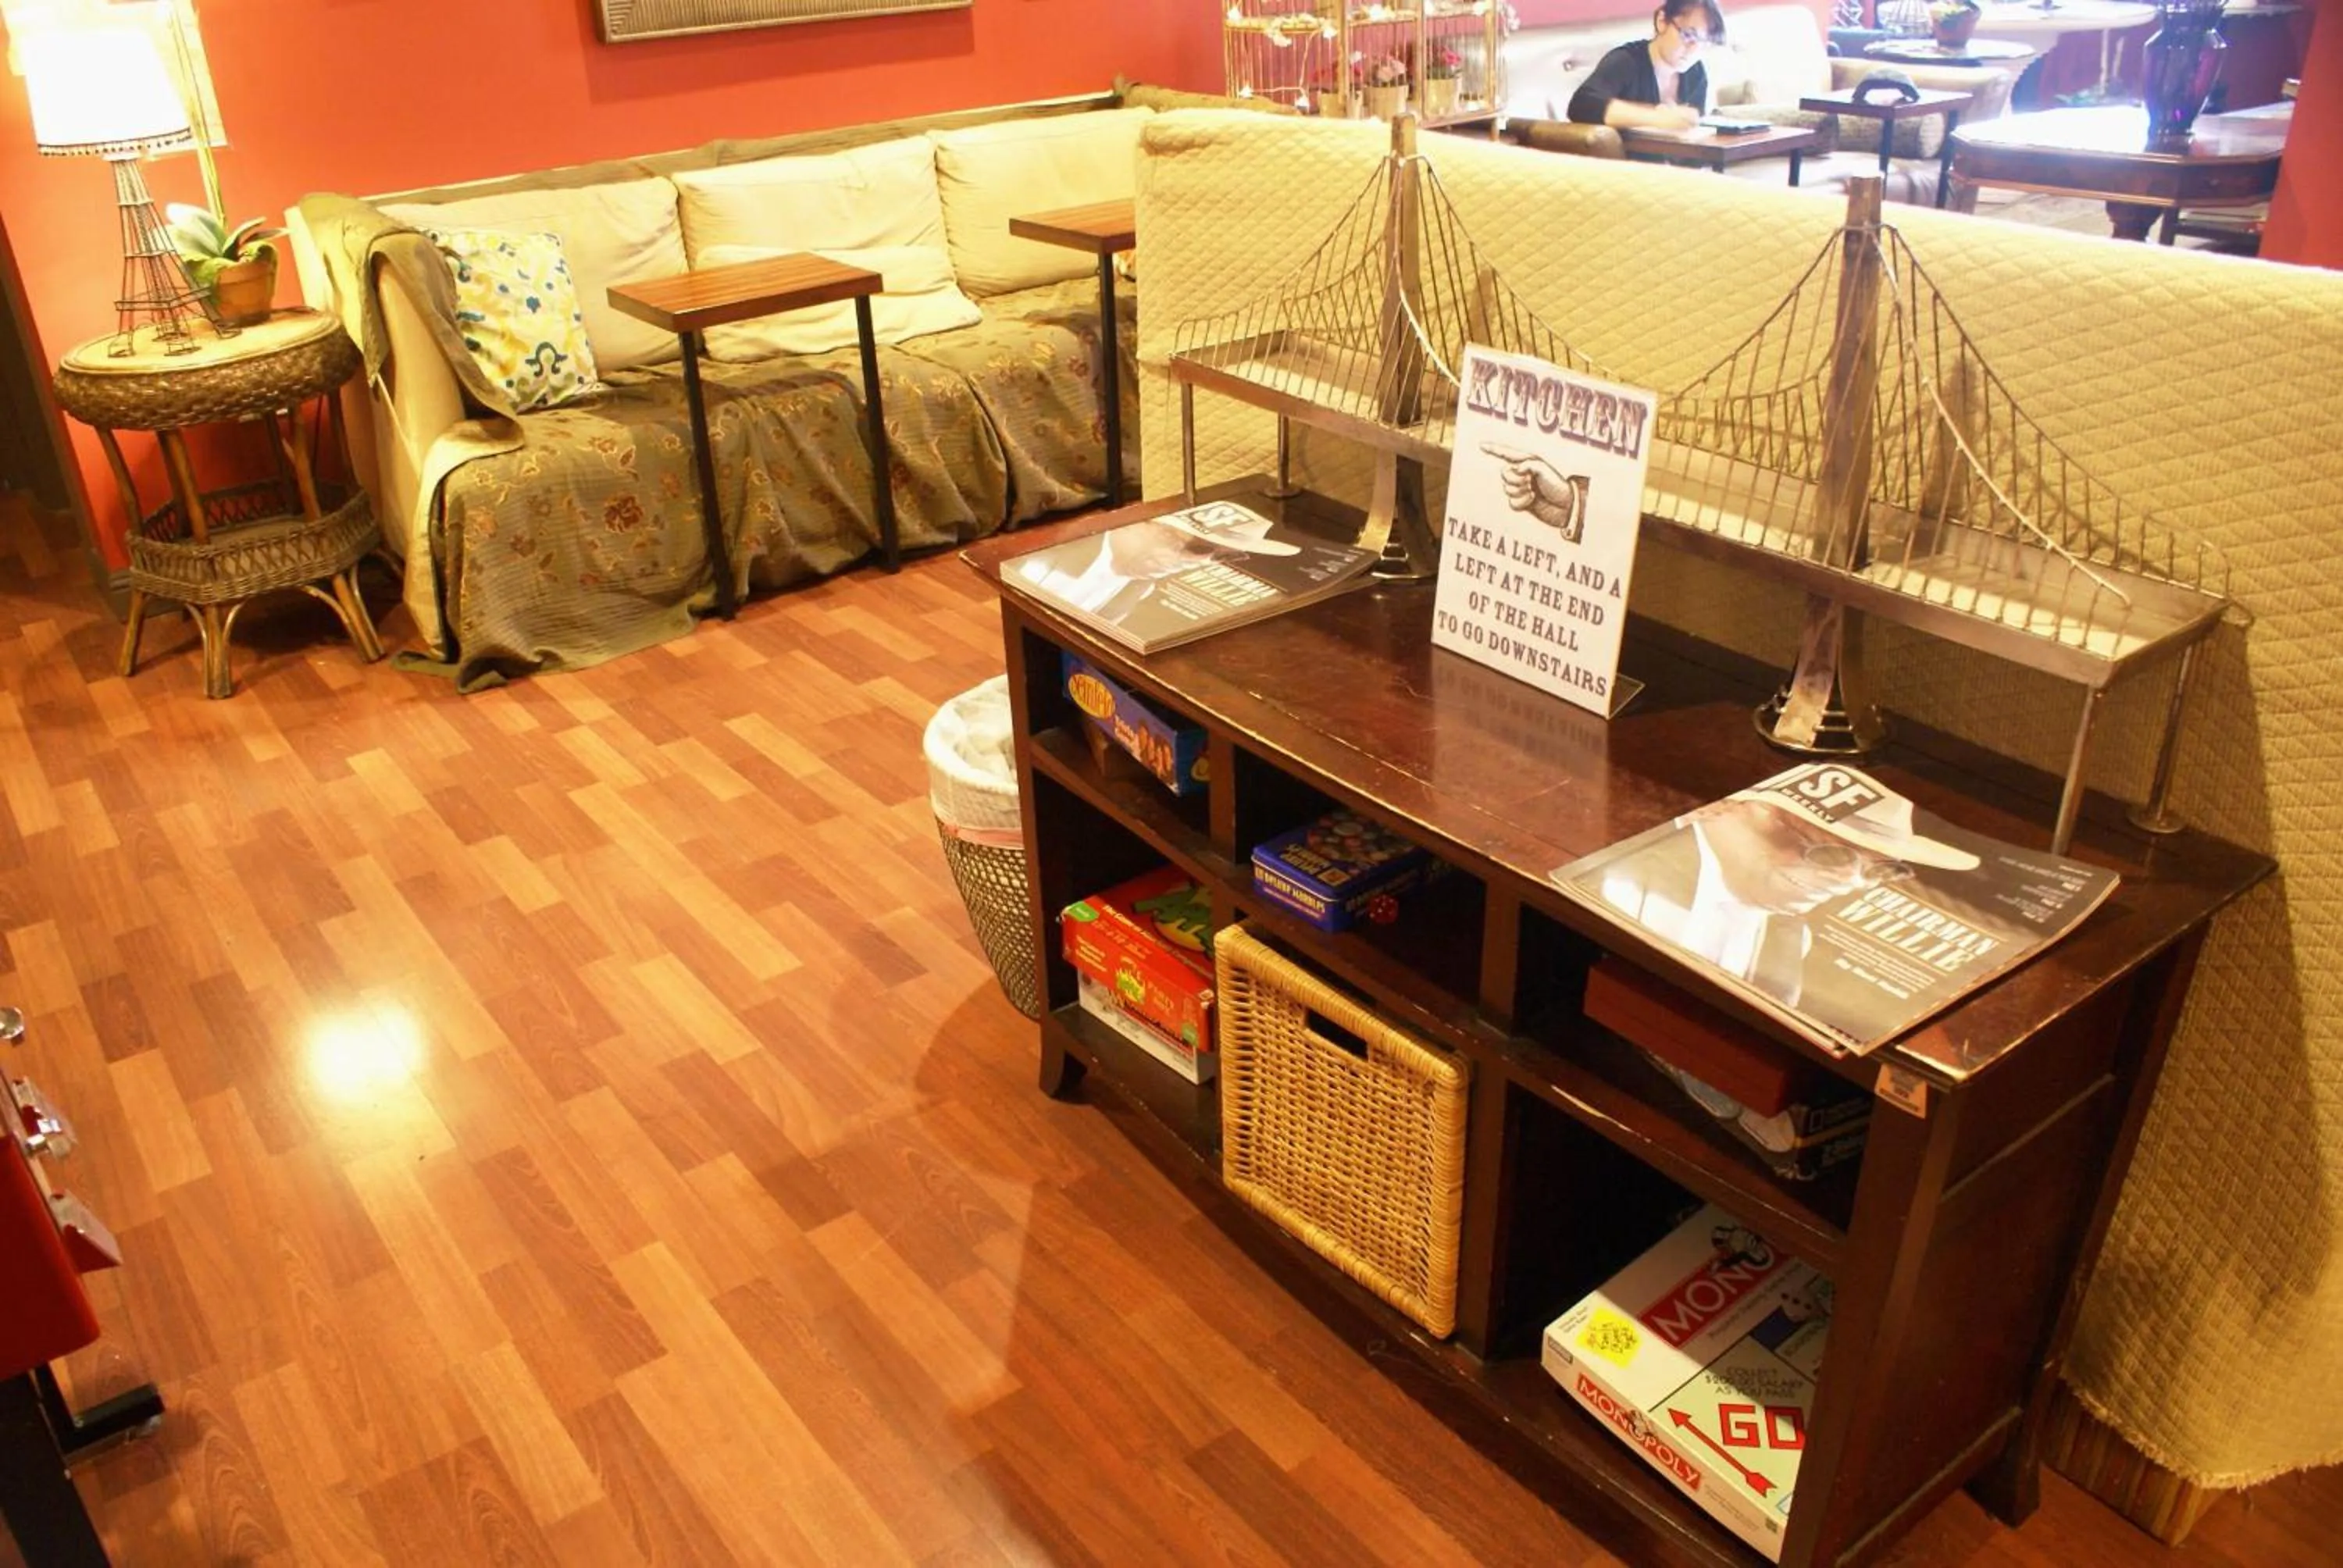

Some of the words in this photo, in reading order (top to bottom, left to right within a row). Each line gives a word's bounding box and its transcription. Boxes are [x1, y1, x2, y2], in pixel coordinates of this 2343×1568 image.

[1467, 357, 1648, 460] KITCHEN
[1193, 505, 1251, 529] SF
[1448, 517, 1492, 550] TAKE
[1496, 536, 1506, 557] A
[1511, 540, 1561, 579] LEFT,
[1565, 561, 1605, 591] AND
[1609, 577, 1622, 599] A
[1454, 552, 1497, 585] LEFT
[1500, 571, 1524, 596] AT
[1528, 580, 1563, 611] THE
[1567, 595, 1605, 626] END
[1437, 610, 1458, 634] TO
[1462, 621, 1483, 645] GO
[1488, 629, 1607, 698] DOWNSTAIRS
[1468, 590, 1491, 615] OF
[1494, 600, 1527, 631] THE
[1531, 615, 1579, 653] HALL
[1798, 770, 1879, 808] SF
[1835, 900, 1977, 972] WILLIE
[1863, 887, 2000, 957] CHAIRMAN
[1718, 1402, 1806, 1450] GO
